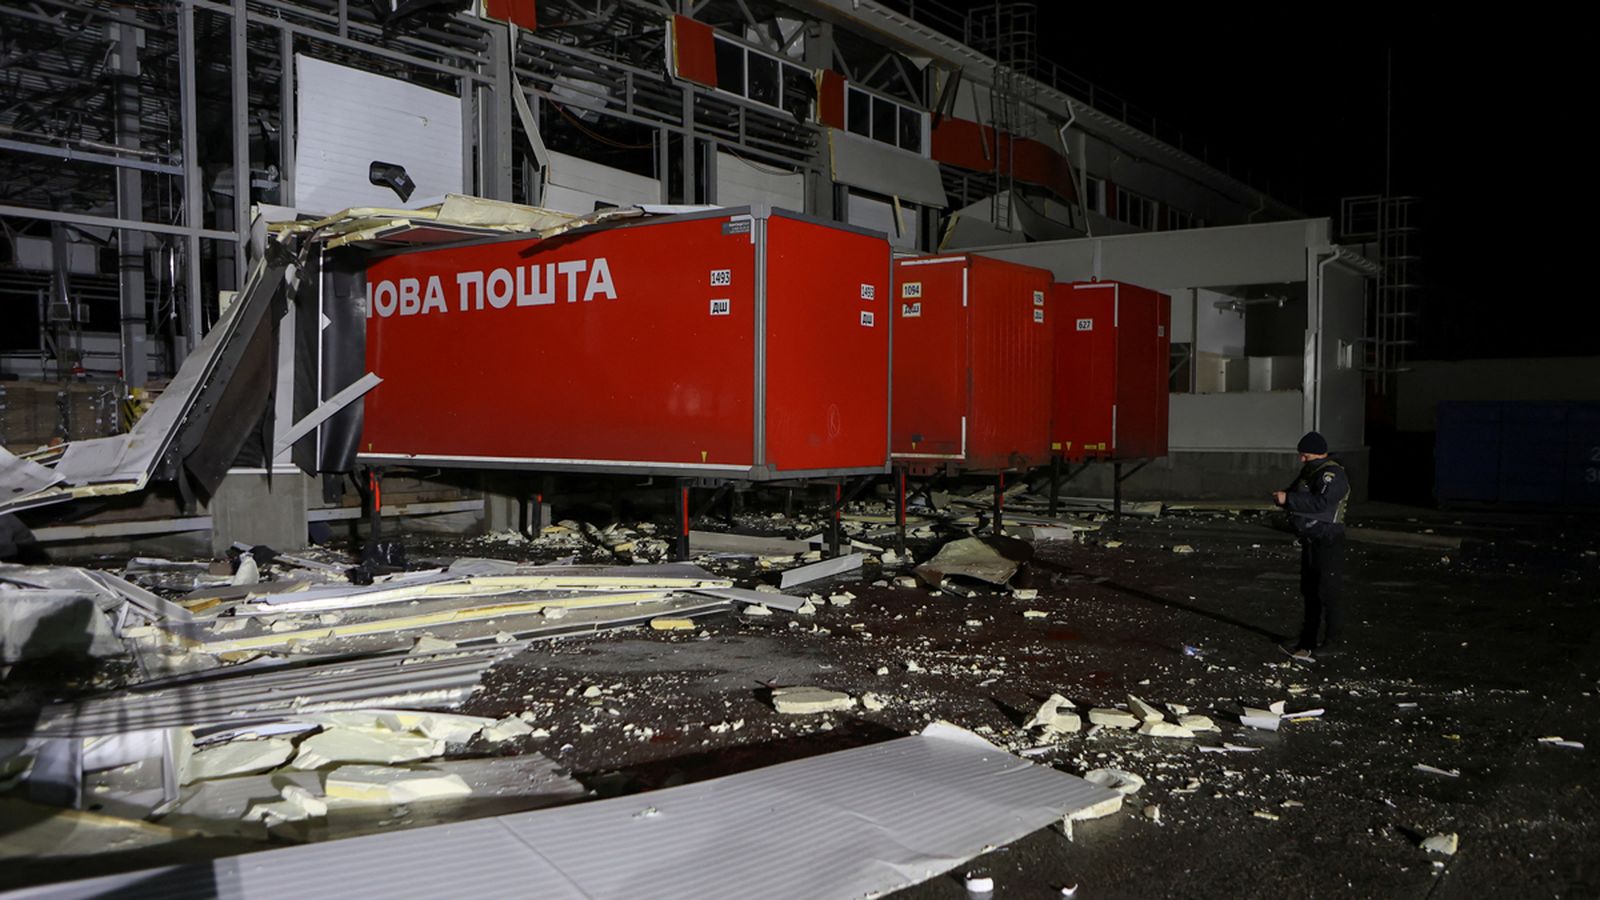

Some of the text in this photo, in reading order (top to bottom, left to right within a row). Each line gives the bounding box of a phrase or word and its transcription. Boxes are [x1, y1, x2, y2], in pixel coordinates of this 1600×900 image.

[711, 271, 730, 284] 1493
[366, 257, 618, 318] ОВА ПОШТА
[904, 284, 920, 296] 1094
[712, 301, 728, 313] ДШ
[1078, 320, 1091, 329] 627
